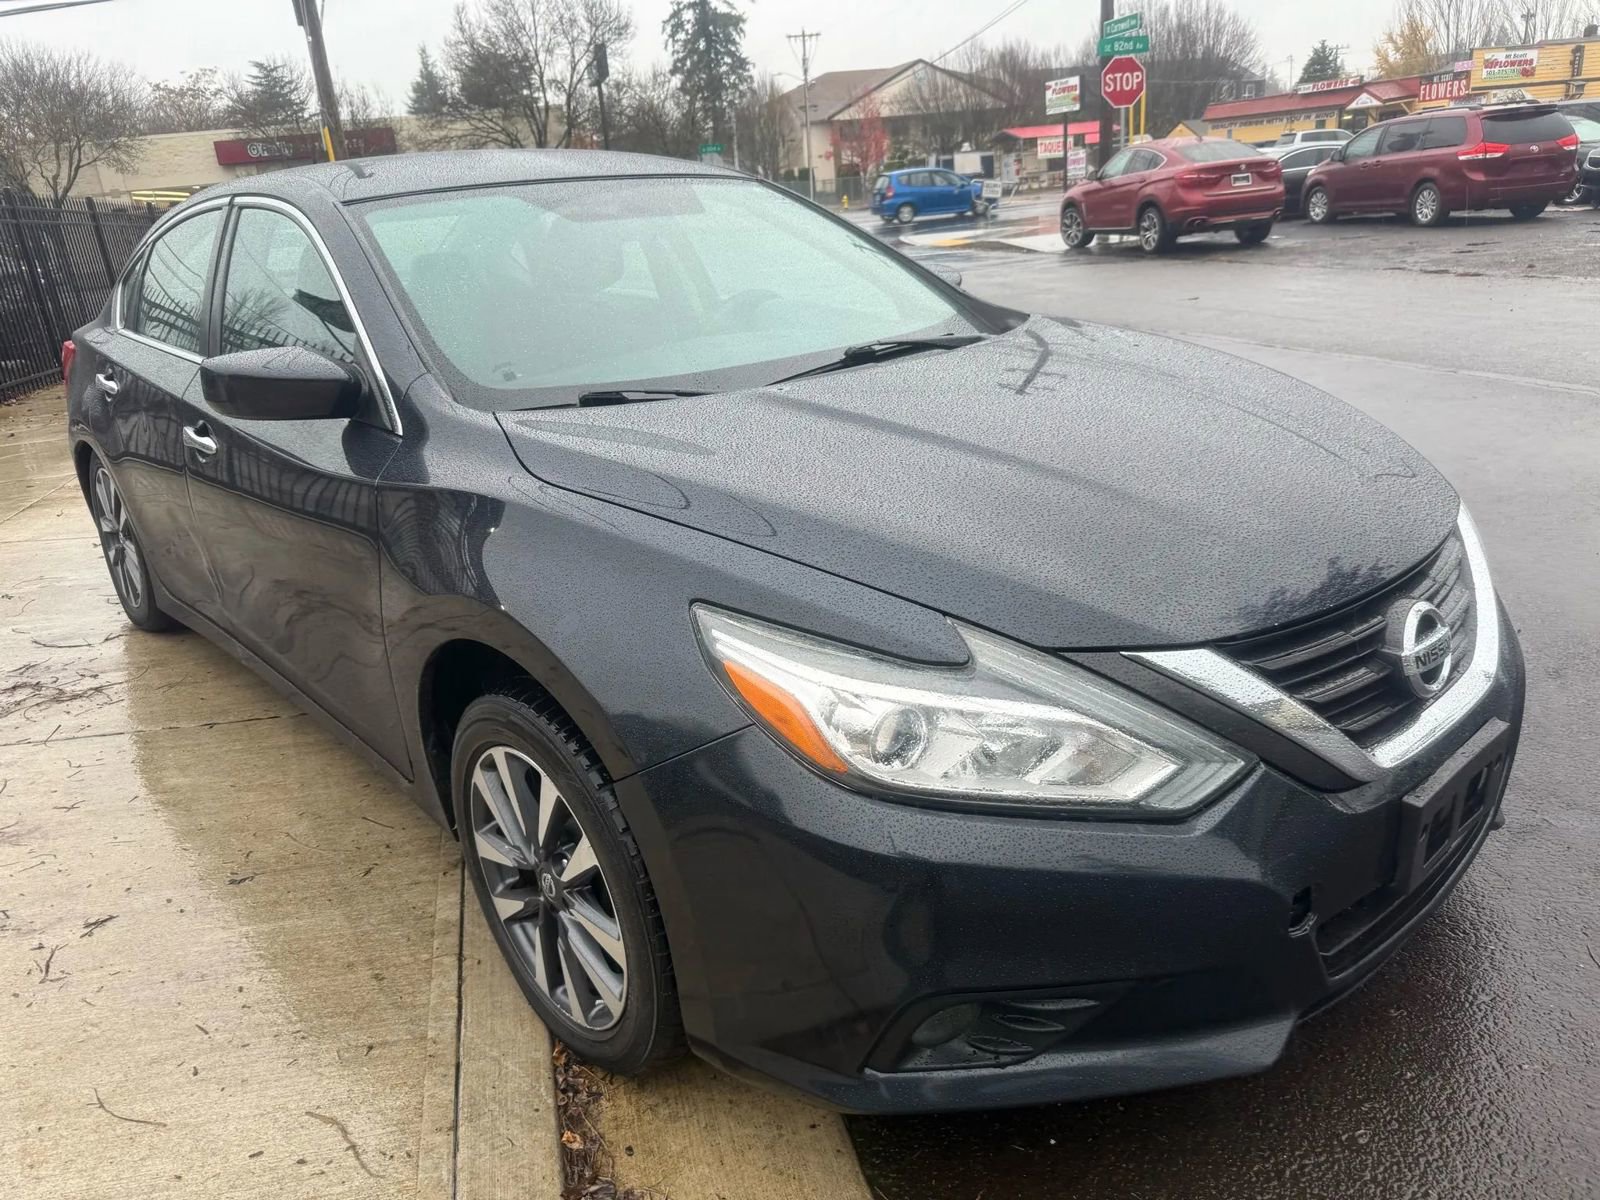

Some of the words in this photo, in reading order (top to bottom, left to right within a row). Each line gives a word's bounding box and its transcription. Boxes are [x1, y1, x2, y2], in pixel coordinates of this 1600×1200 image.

[1113, 40, 1133, 52] 82nd
[1494, 58, 1534, 69] FLOWERS
[1105, 71, 1142, 92] STOP
[1312, 78, 1349, 91] FLOWERS
[1420, 79, 1467, 100] FLOWERS
